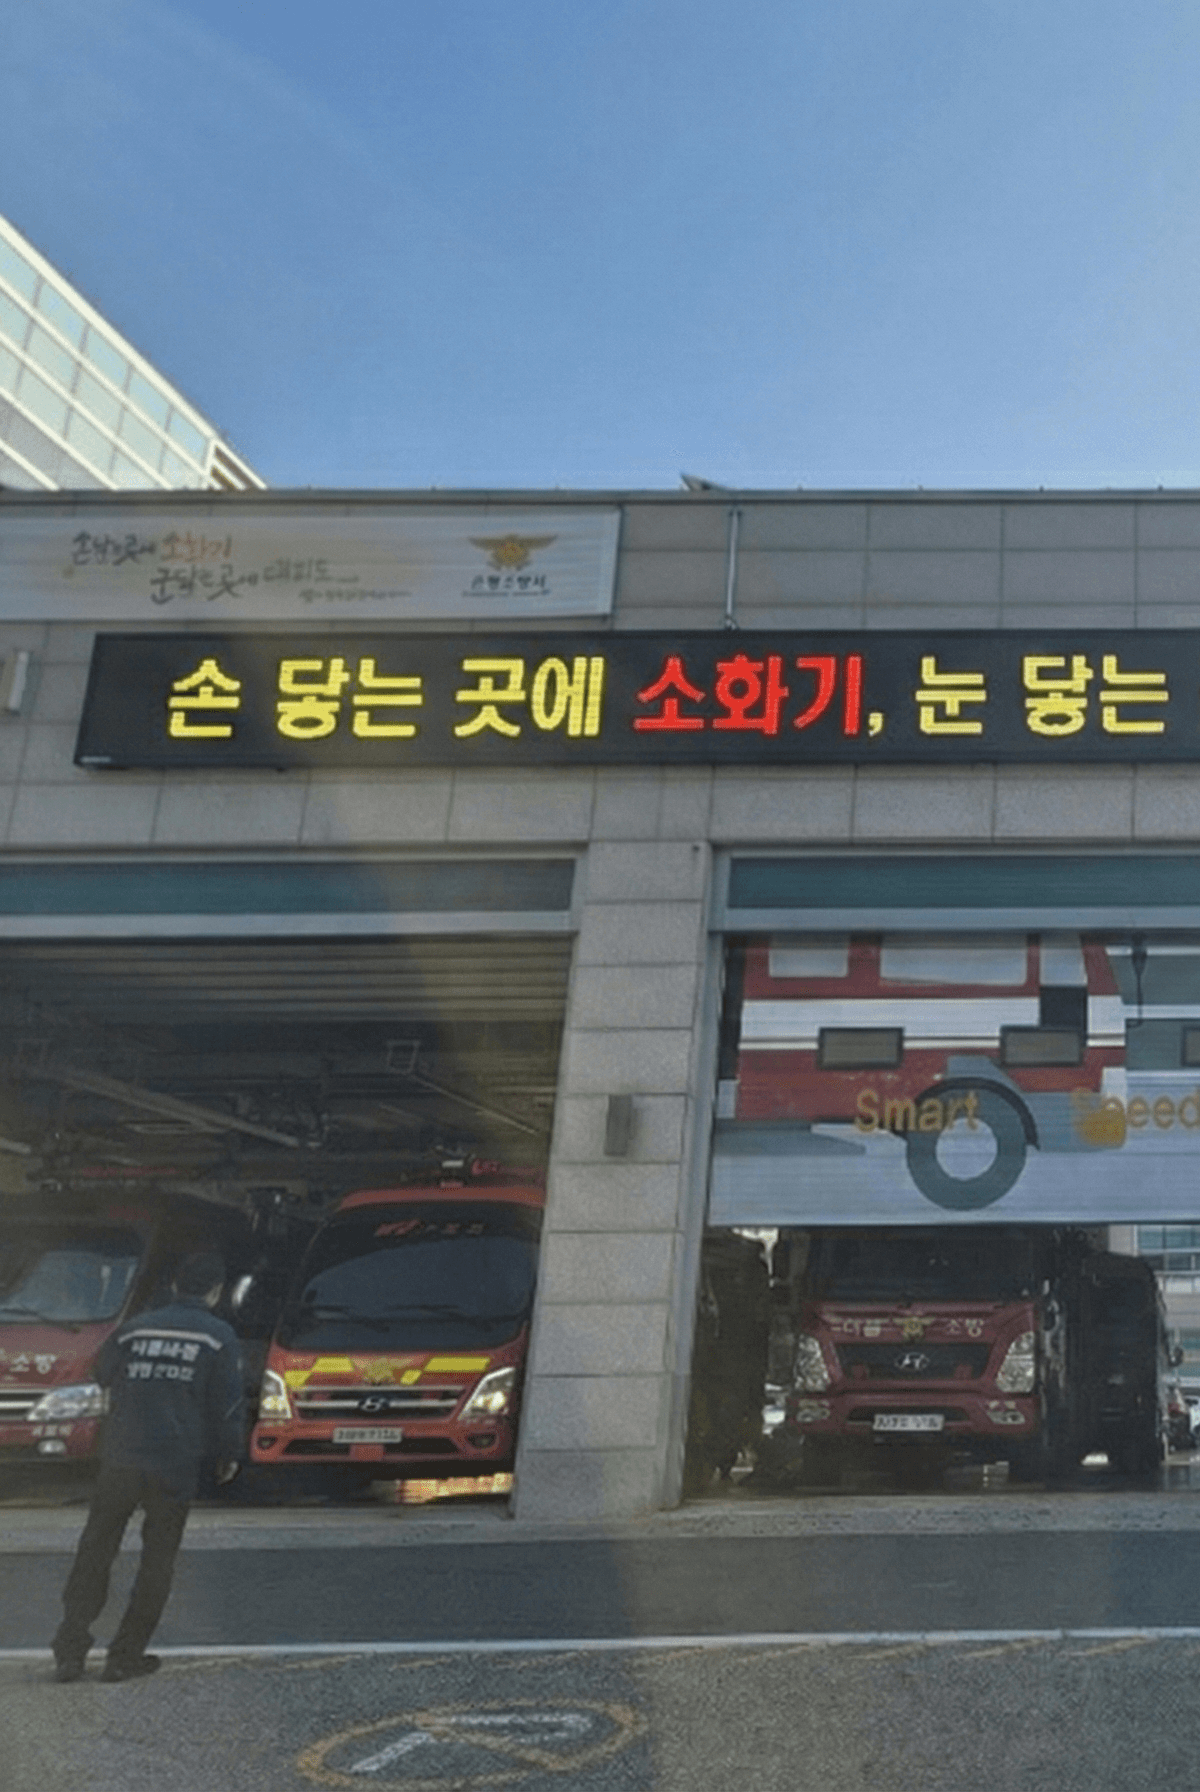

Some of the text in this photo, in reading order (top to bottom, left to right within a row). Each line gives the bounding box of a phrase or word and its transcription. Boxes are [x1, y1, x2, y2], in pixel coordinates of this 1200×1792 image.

[169, 659, 241, 738] 손
[277, 658, 422, 738] 닿는
[454, 657, 605, 737] 곳에
[633, 654, 884, 737] 소화기,
[915, 656, 987, 735] 눈
[1023, 655, 1170, 736] 닿는
[854, 1088, 981, 1134] Smart
